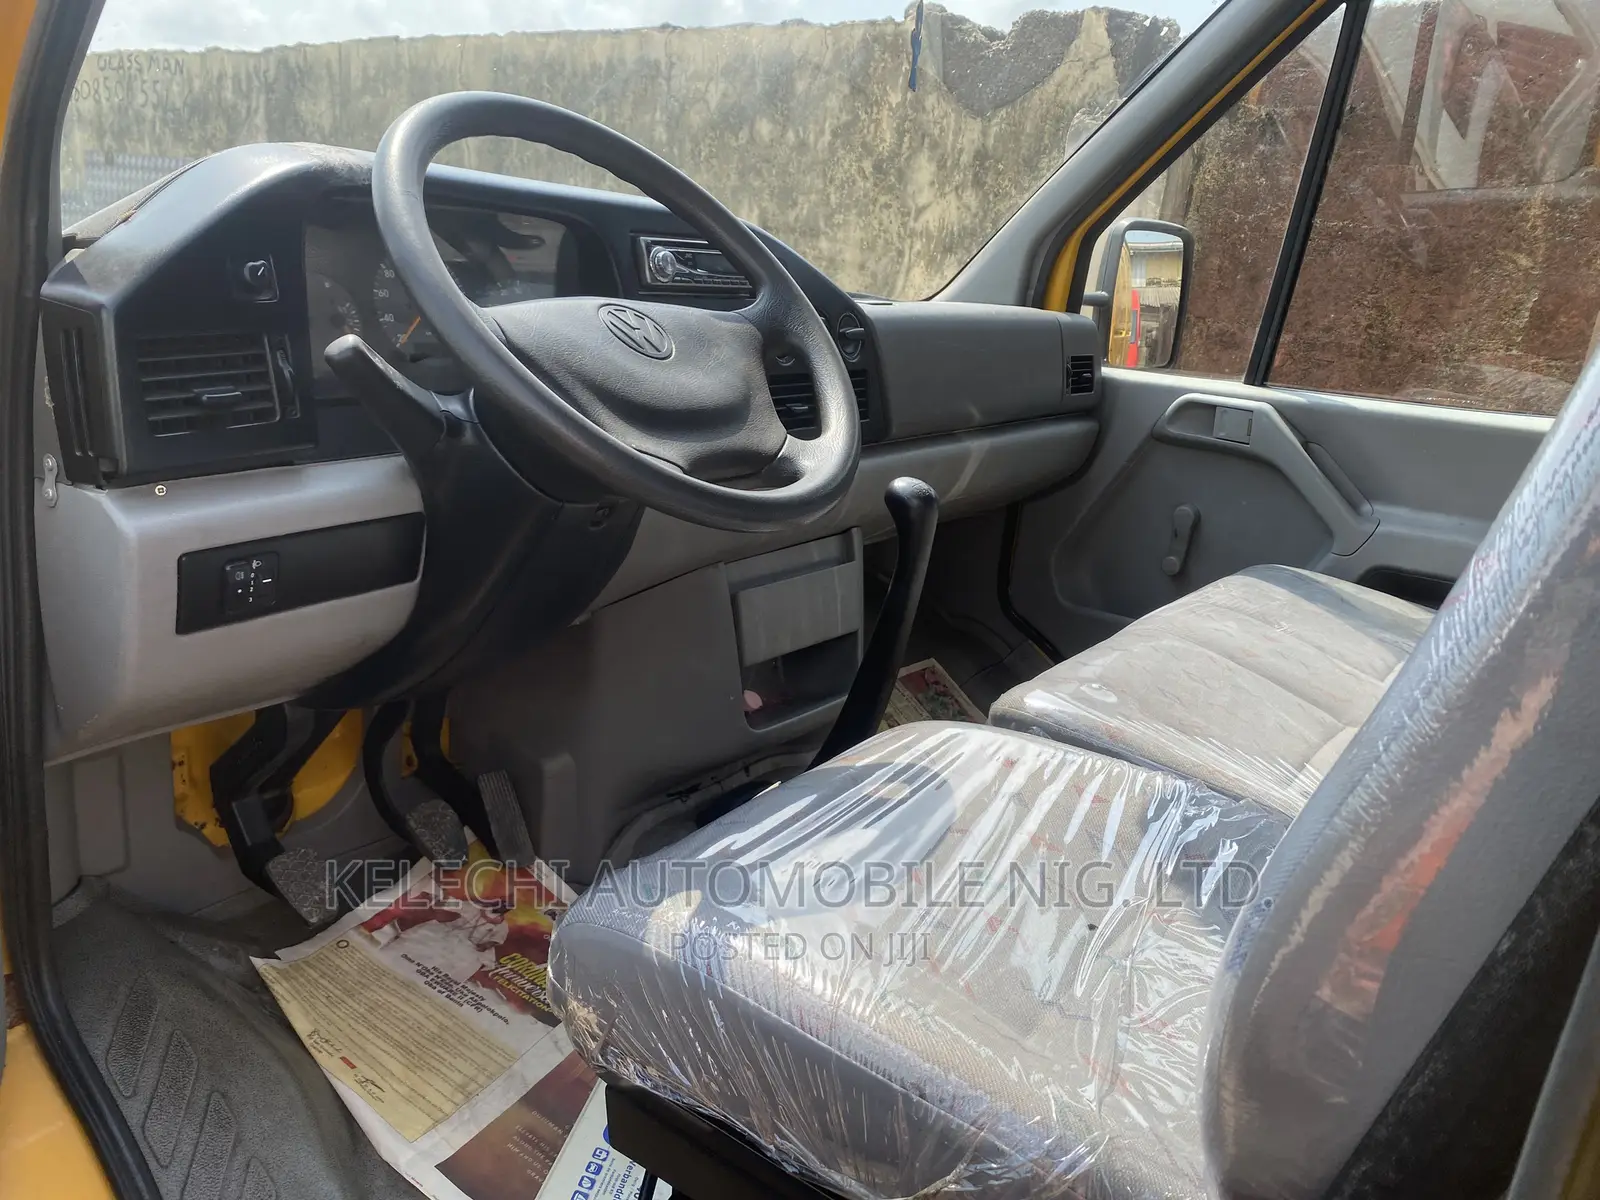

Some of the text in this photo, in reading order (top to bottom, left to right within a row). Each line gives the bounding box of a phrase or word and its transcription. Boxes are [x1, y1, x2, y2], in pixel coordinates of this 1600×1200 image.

[96, 53, 185, 76] GLASS MAN
[383, 269, 395, 278] 80
[378, 289, 389, 298] 60
[383, 313, 395, 322] 40
[461, 981, 487, 1002] Majesty
[612, 1160, 637, 1200] Verbandd
